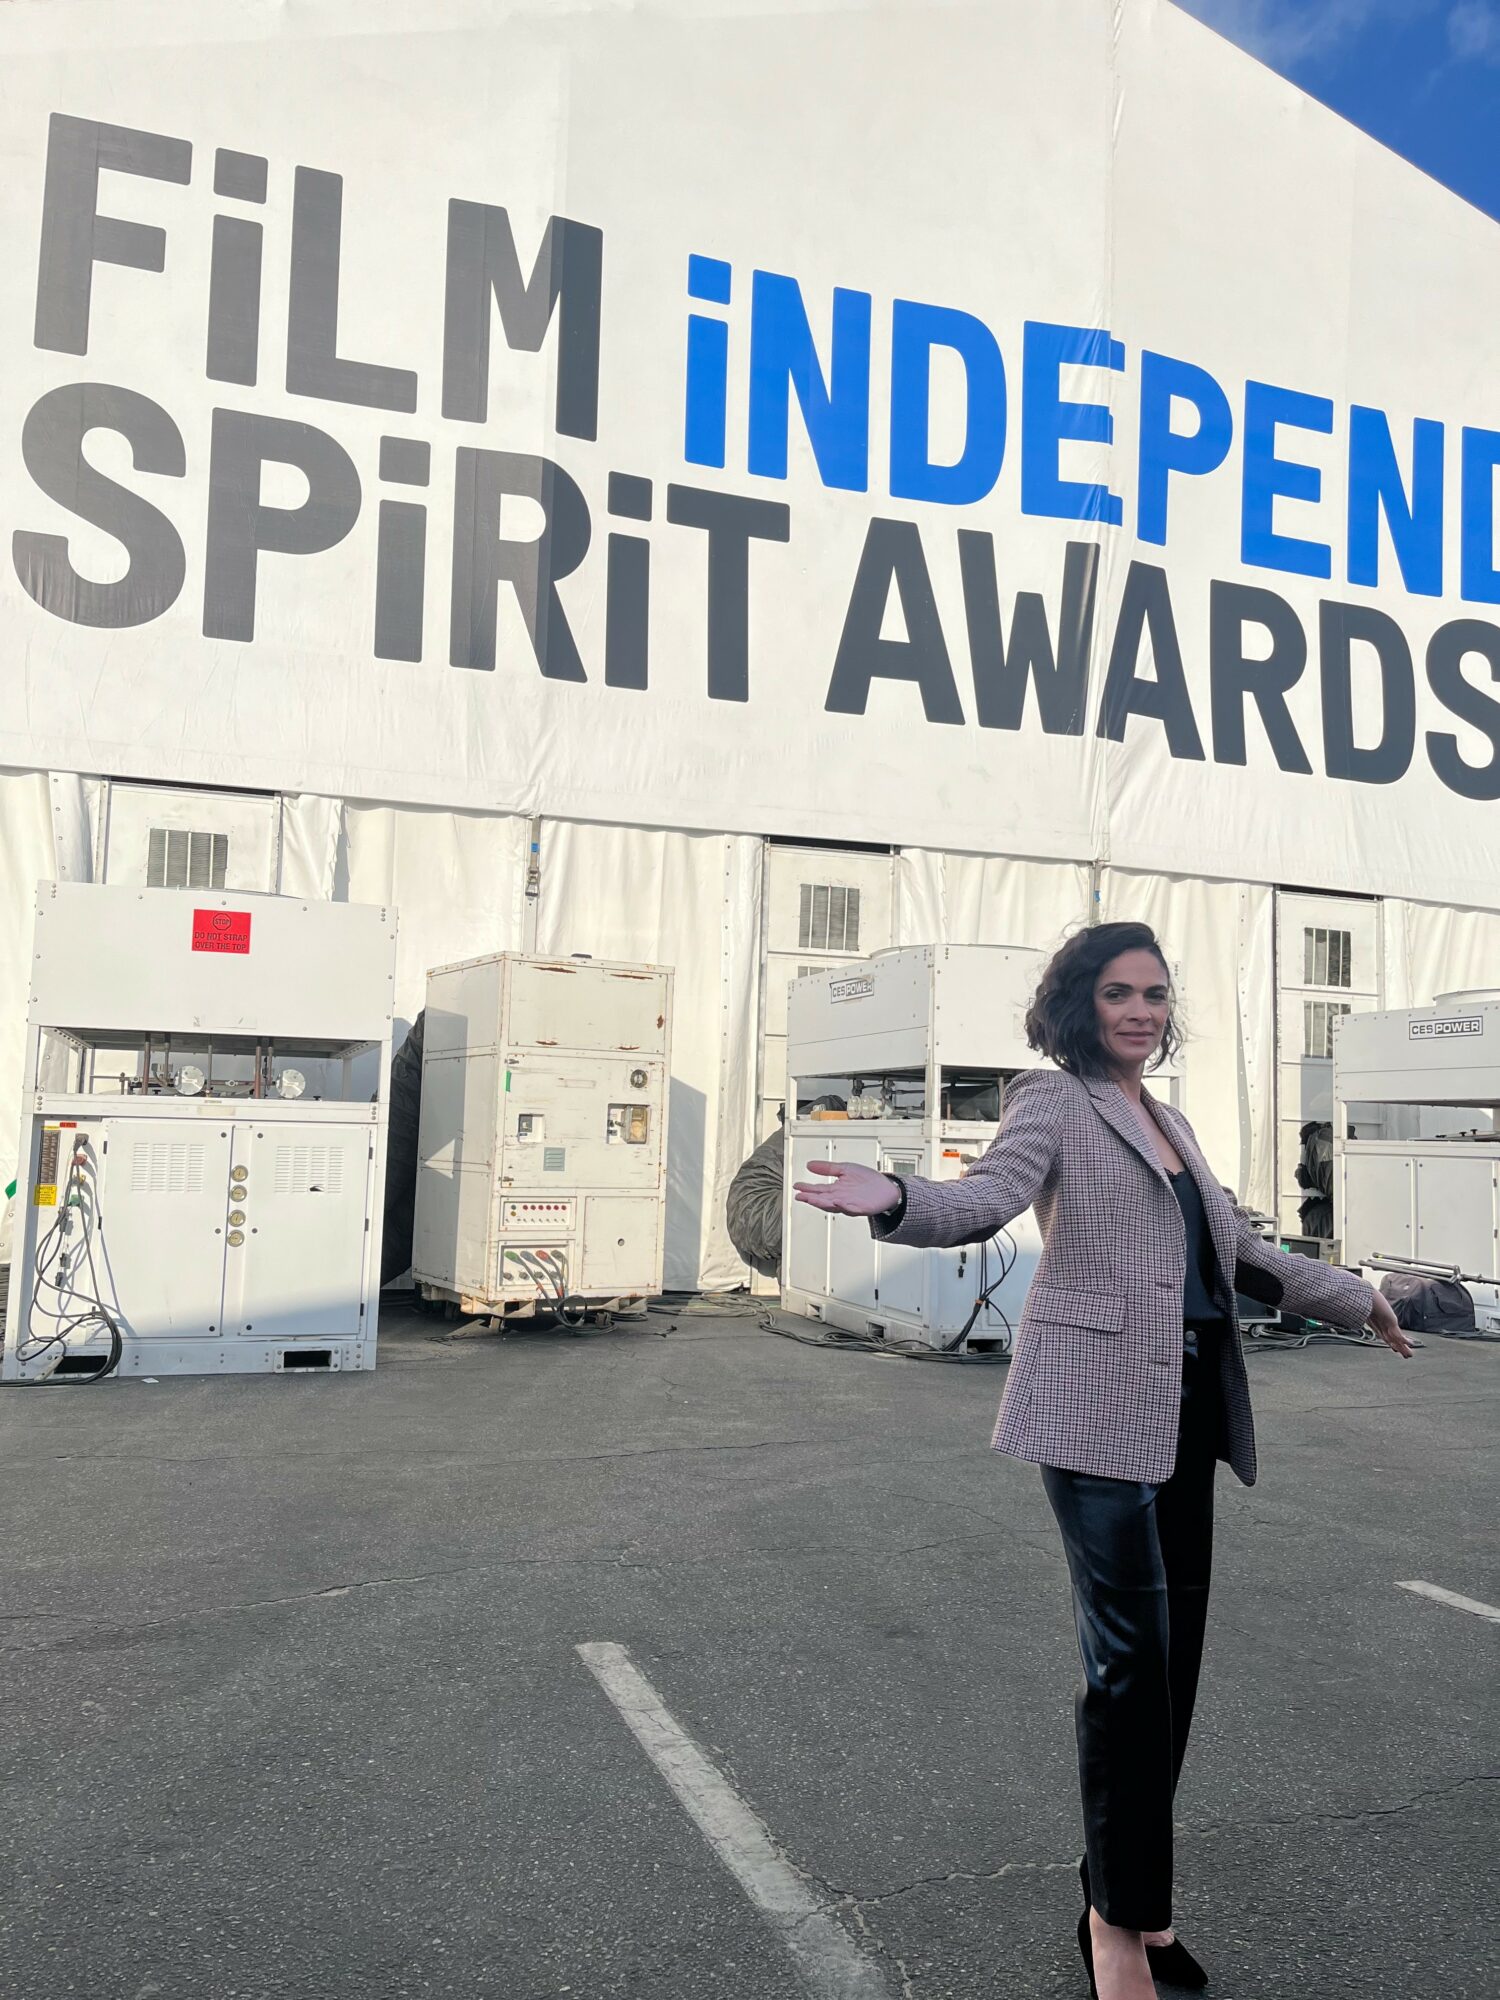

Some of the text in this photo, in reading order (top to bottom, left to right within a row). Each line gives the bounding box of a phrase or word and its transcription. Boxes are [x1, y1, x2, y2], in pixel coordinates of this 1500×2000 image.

[824, 516, 1500, 801] AWARDS
[833, 982, 872, 997] CES POWER
[1412, 1021, 1479, 1034] CES POWER
